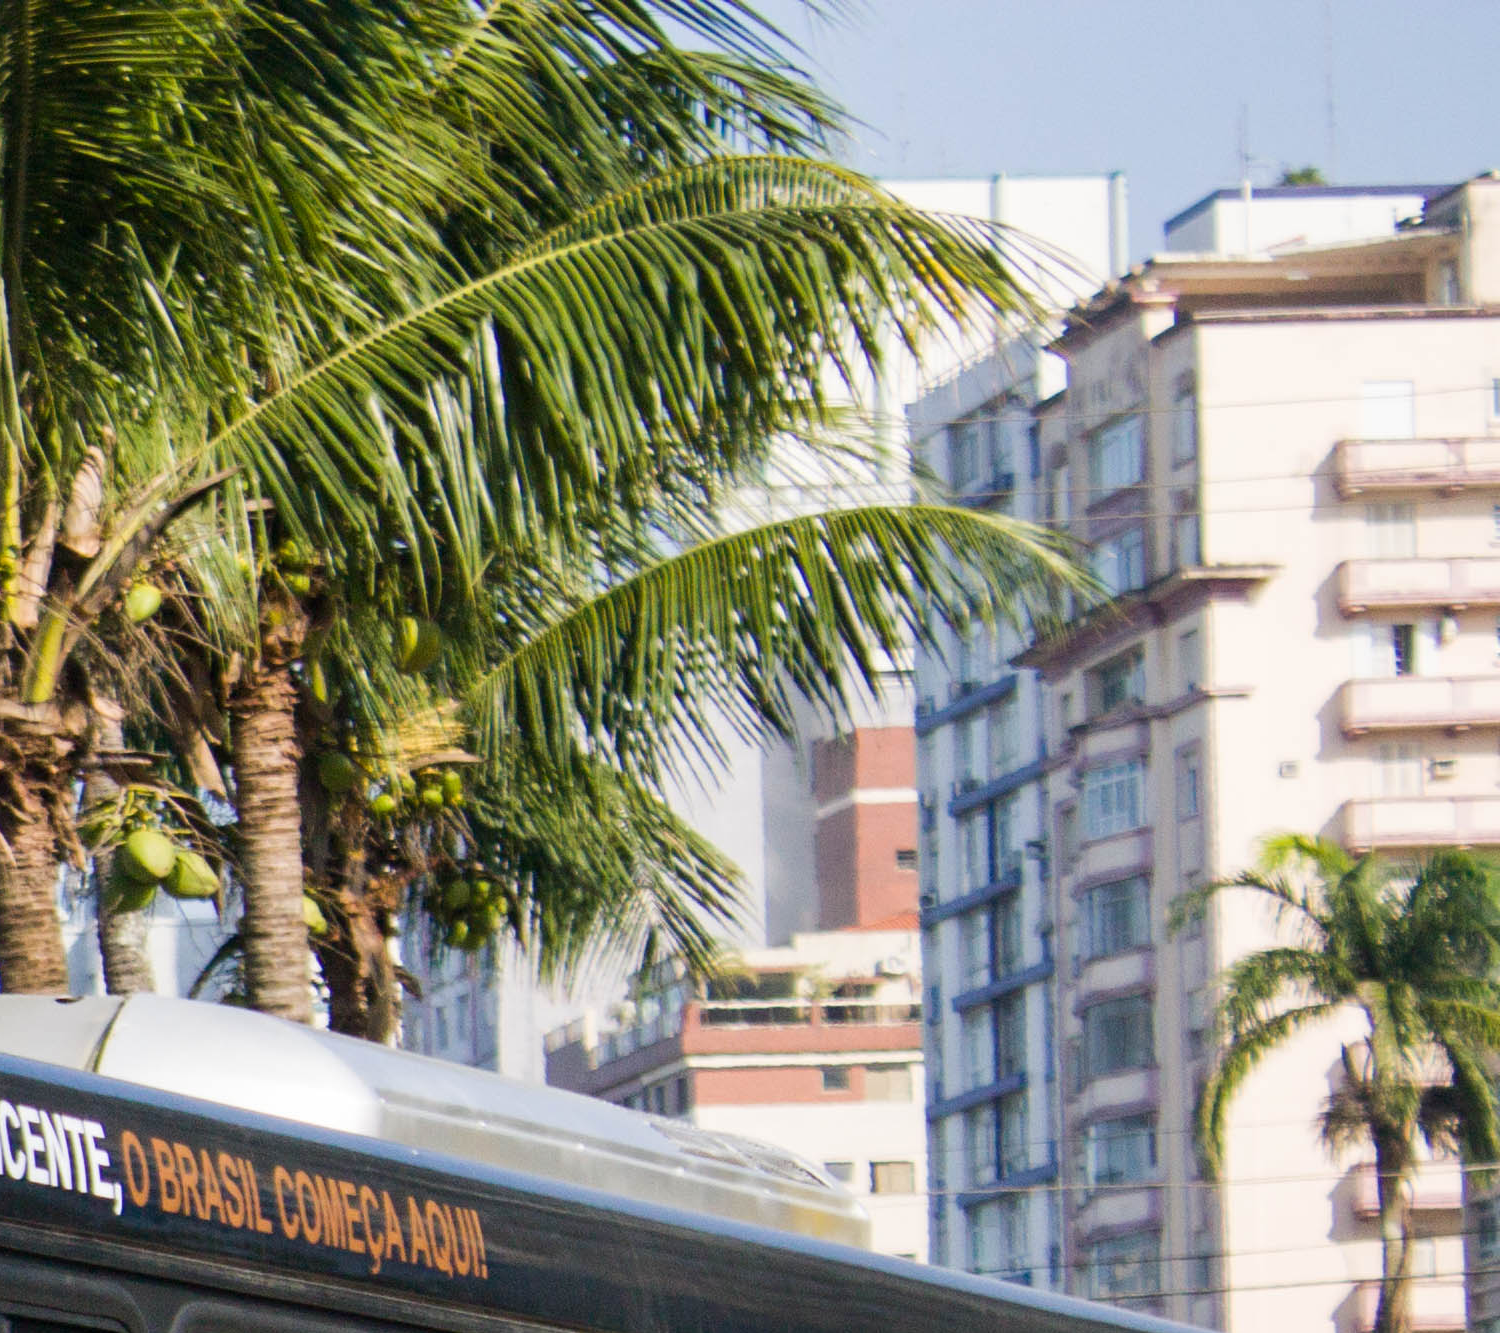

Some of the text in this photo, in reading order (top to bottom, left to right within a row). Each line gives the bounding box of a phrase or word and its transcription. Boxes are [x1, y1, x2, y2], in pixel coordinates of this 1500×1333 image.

[121, 1130, 150, 1208] O
[157, 1137, 273, 1236] BRASIL
[271, 1164, 401, 1273] COMEÇA
[406, 1198, 489, 1280] AQUI!
